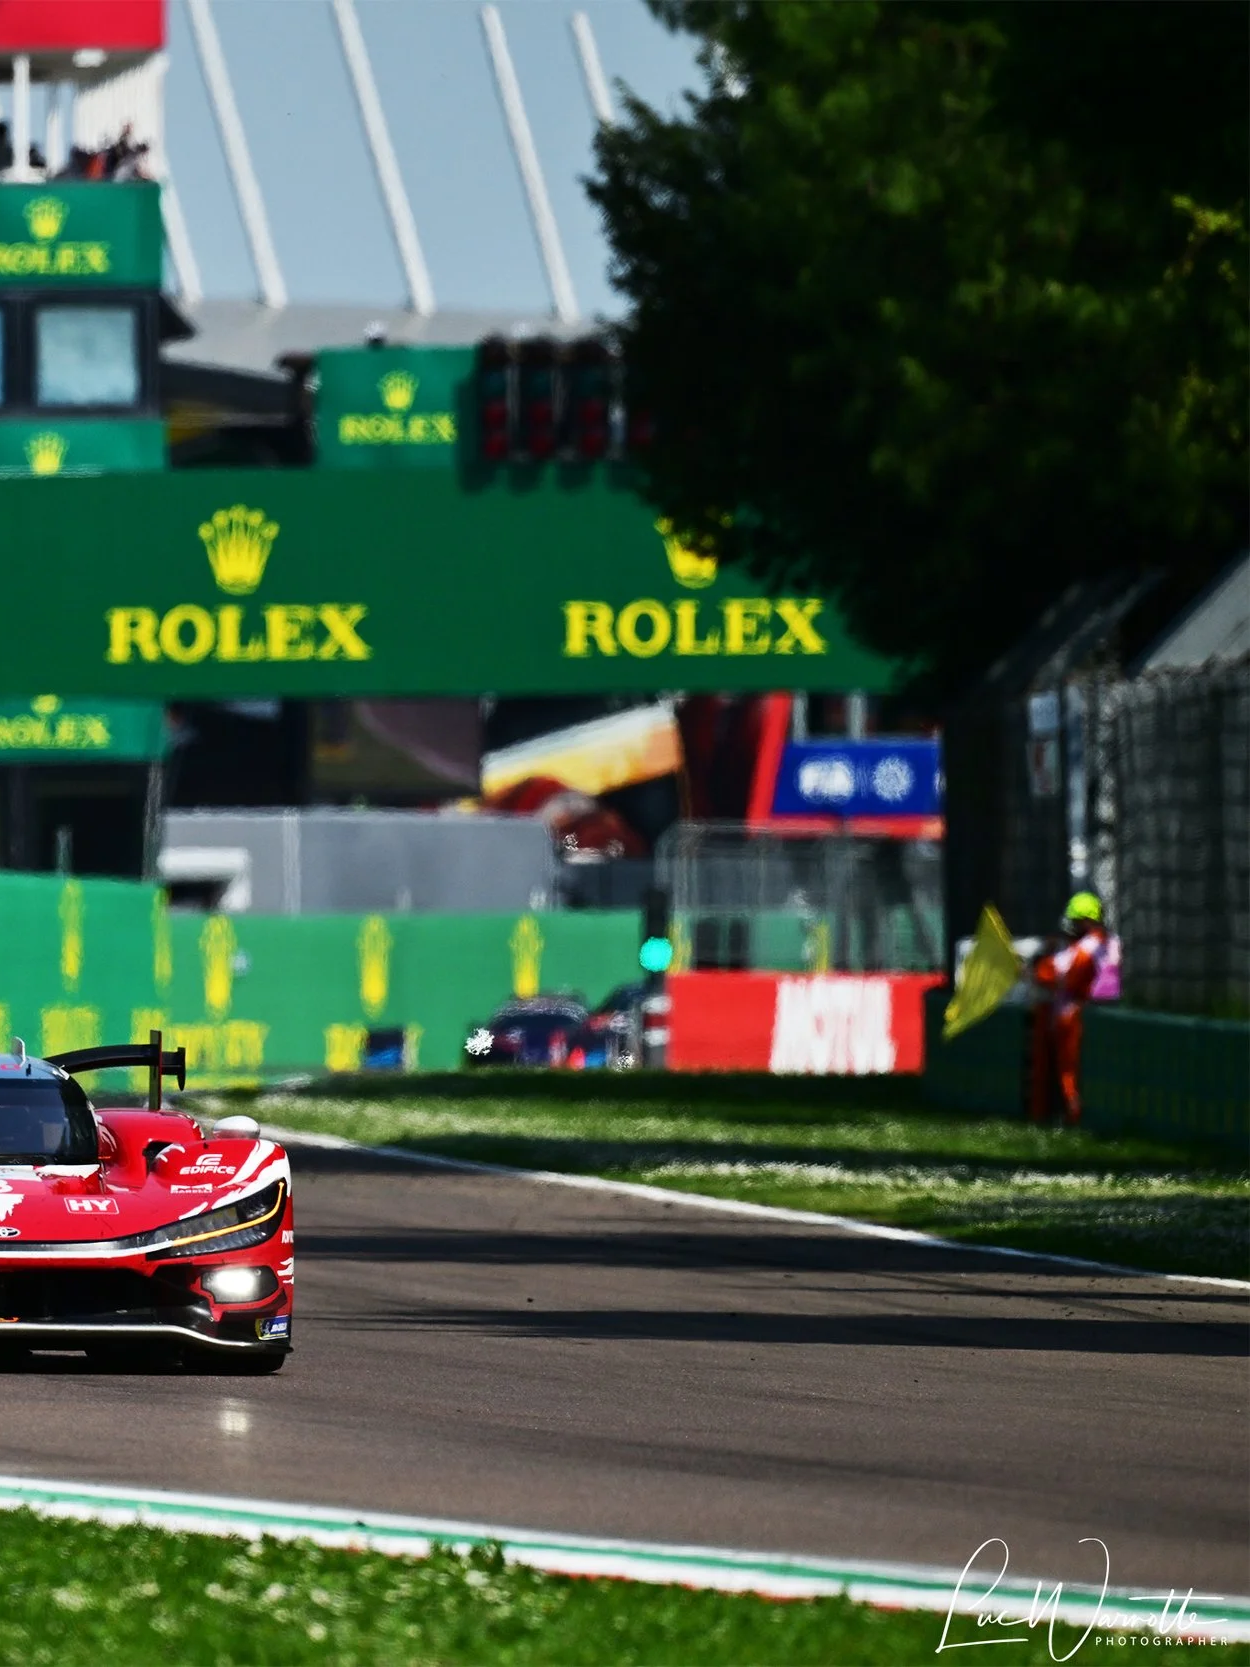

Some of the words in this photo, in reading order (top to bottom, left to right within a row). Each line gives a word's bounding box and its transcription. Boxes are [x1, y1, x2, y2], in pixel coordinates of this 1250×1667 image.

[339, 414, 457, 444] ROLEX
[106, 602, 370, 666] ROLEX
[563, 597, 827, 659] ROLEX
[180, 1166, 236, 1175] EDIFICE
[67, 1198, 112, 1213] HY
